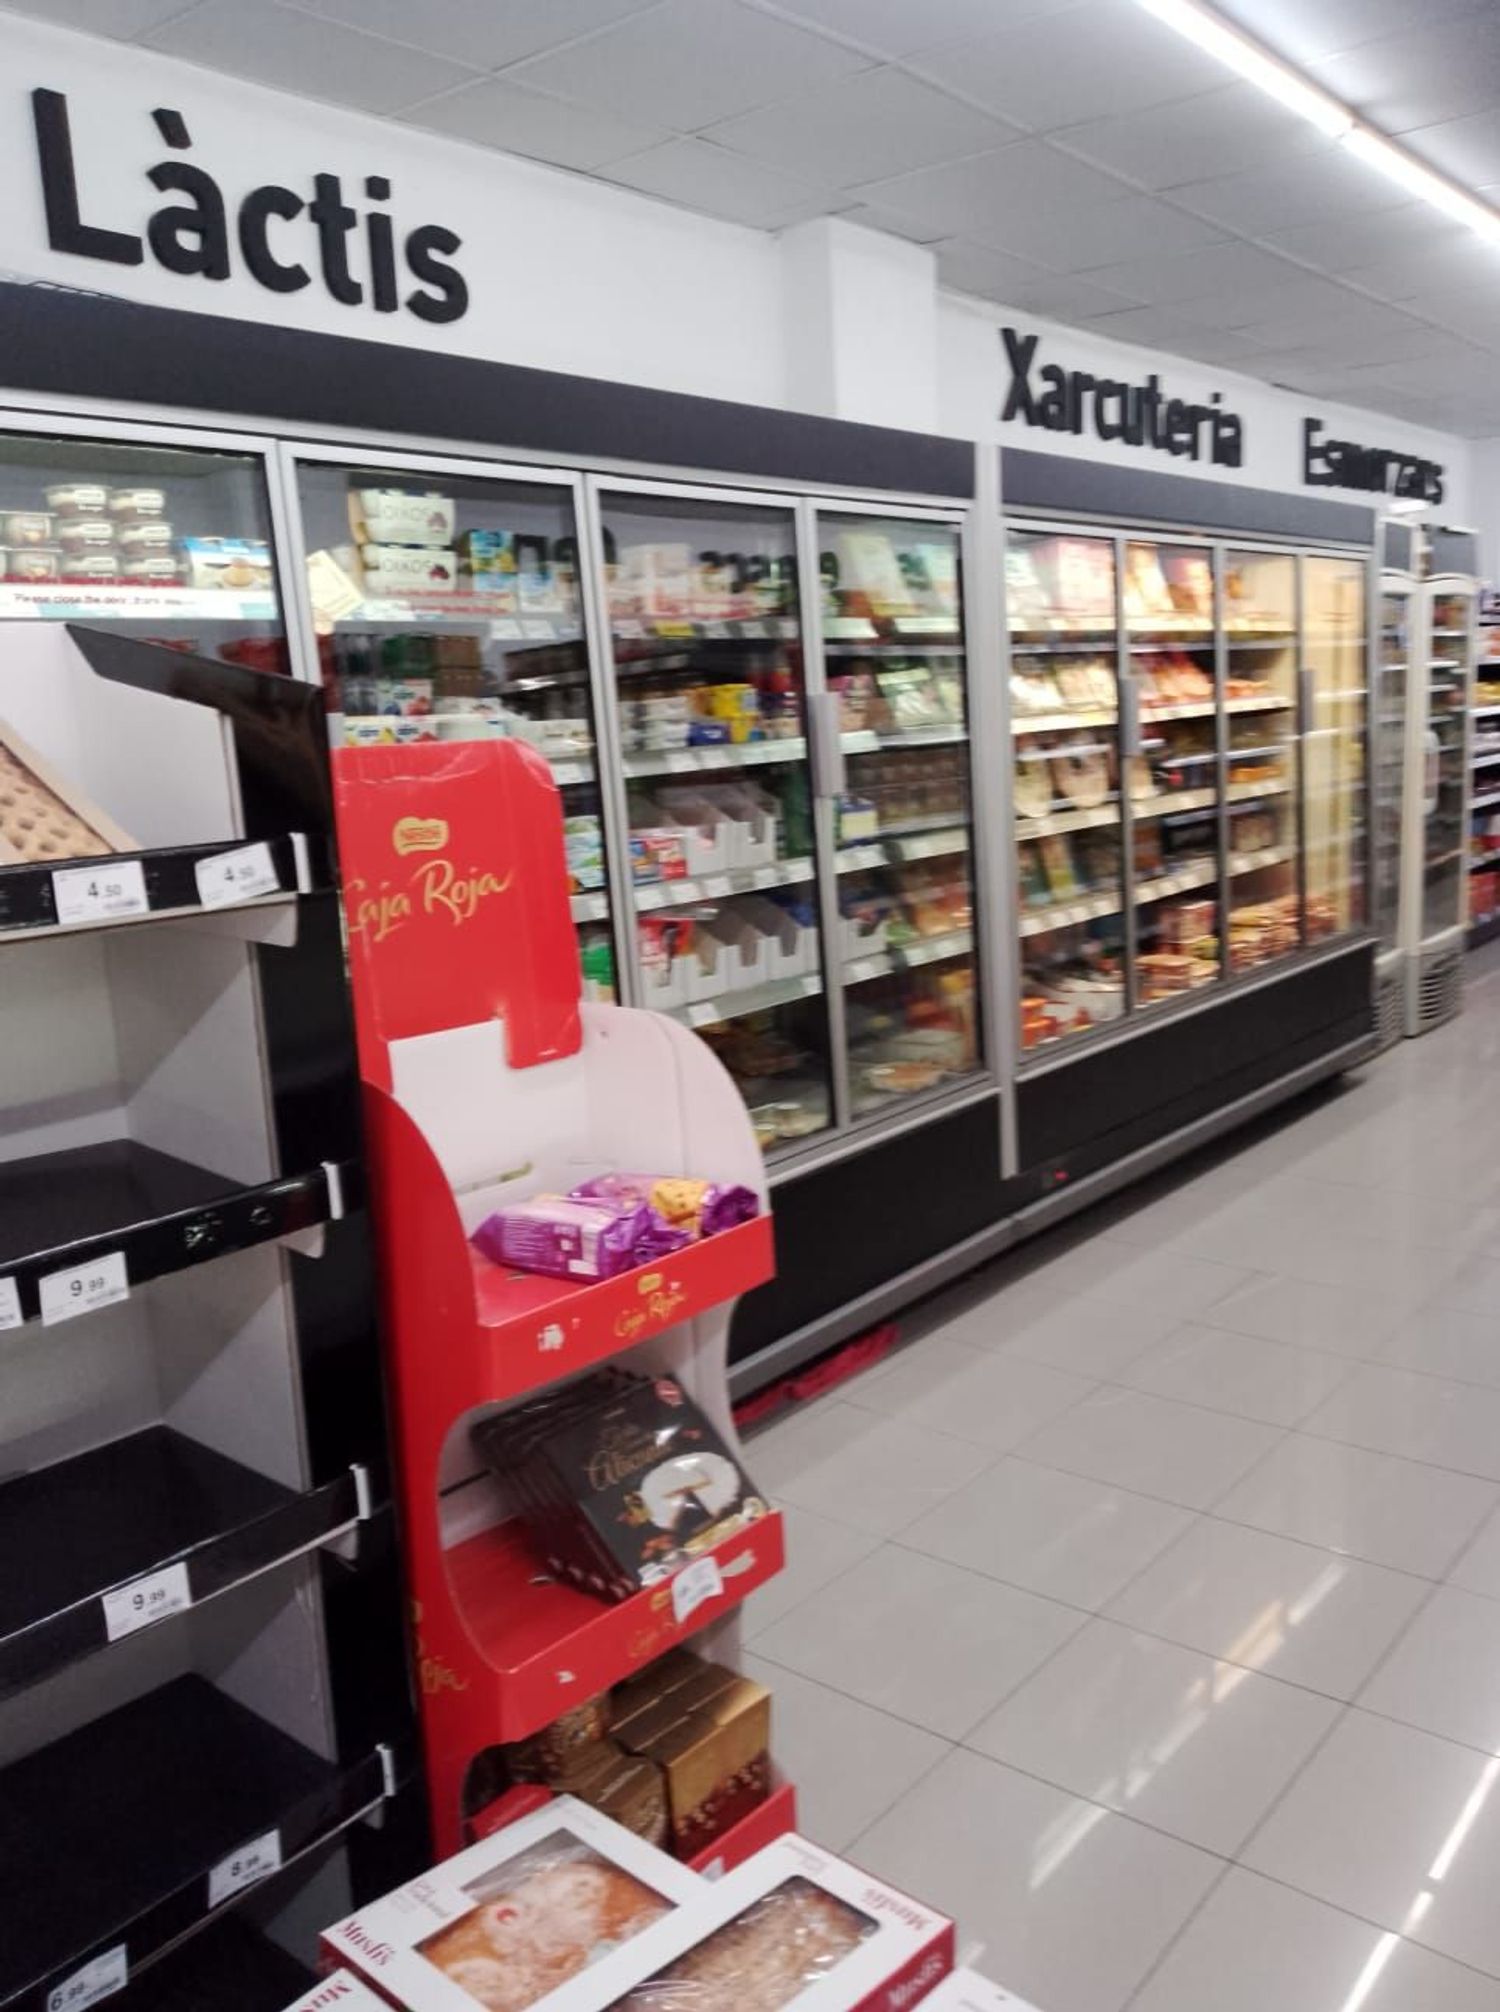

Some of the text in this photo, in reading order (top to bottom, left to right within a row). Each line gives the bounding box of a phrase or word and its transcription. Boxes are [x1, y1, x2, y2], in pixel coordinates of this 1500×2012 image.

[31, 87, 468, 324] Làctis
[999, 328, 1242, 468] Xarcuteria
[409, 859, 515, 927] Roja
